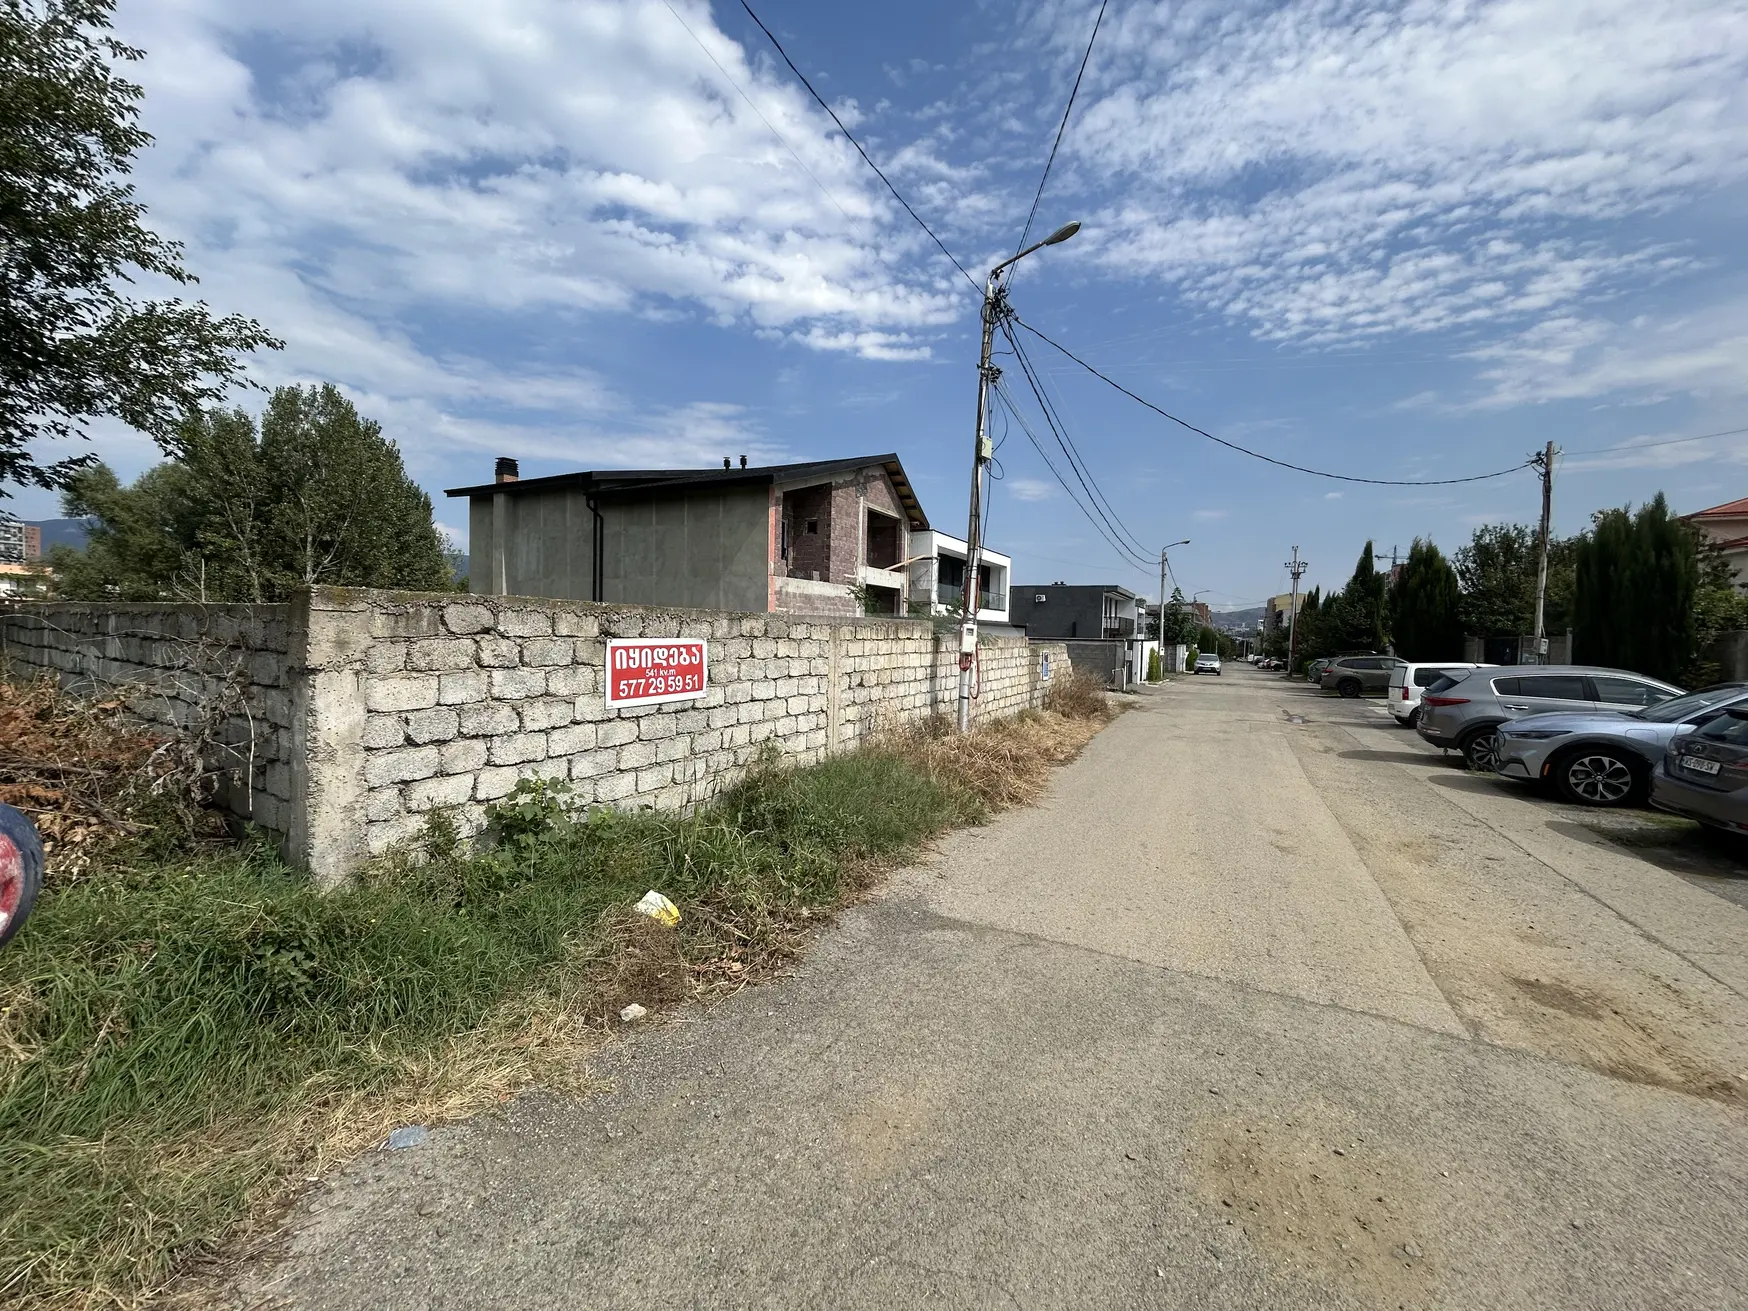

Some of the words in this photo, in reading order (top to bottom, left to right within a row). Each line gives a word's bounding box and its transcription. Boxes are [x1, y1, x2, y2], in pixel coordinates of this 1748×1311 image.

[646, 669, 657, 677] 541
[619, 679, 646, 697] 577
[649, 678, 665, 694] 29
[667, 676, 683, 692] 59
[685, 674, 699, 690] 51
